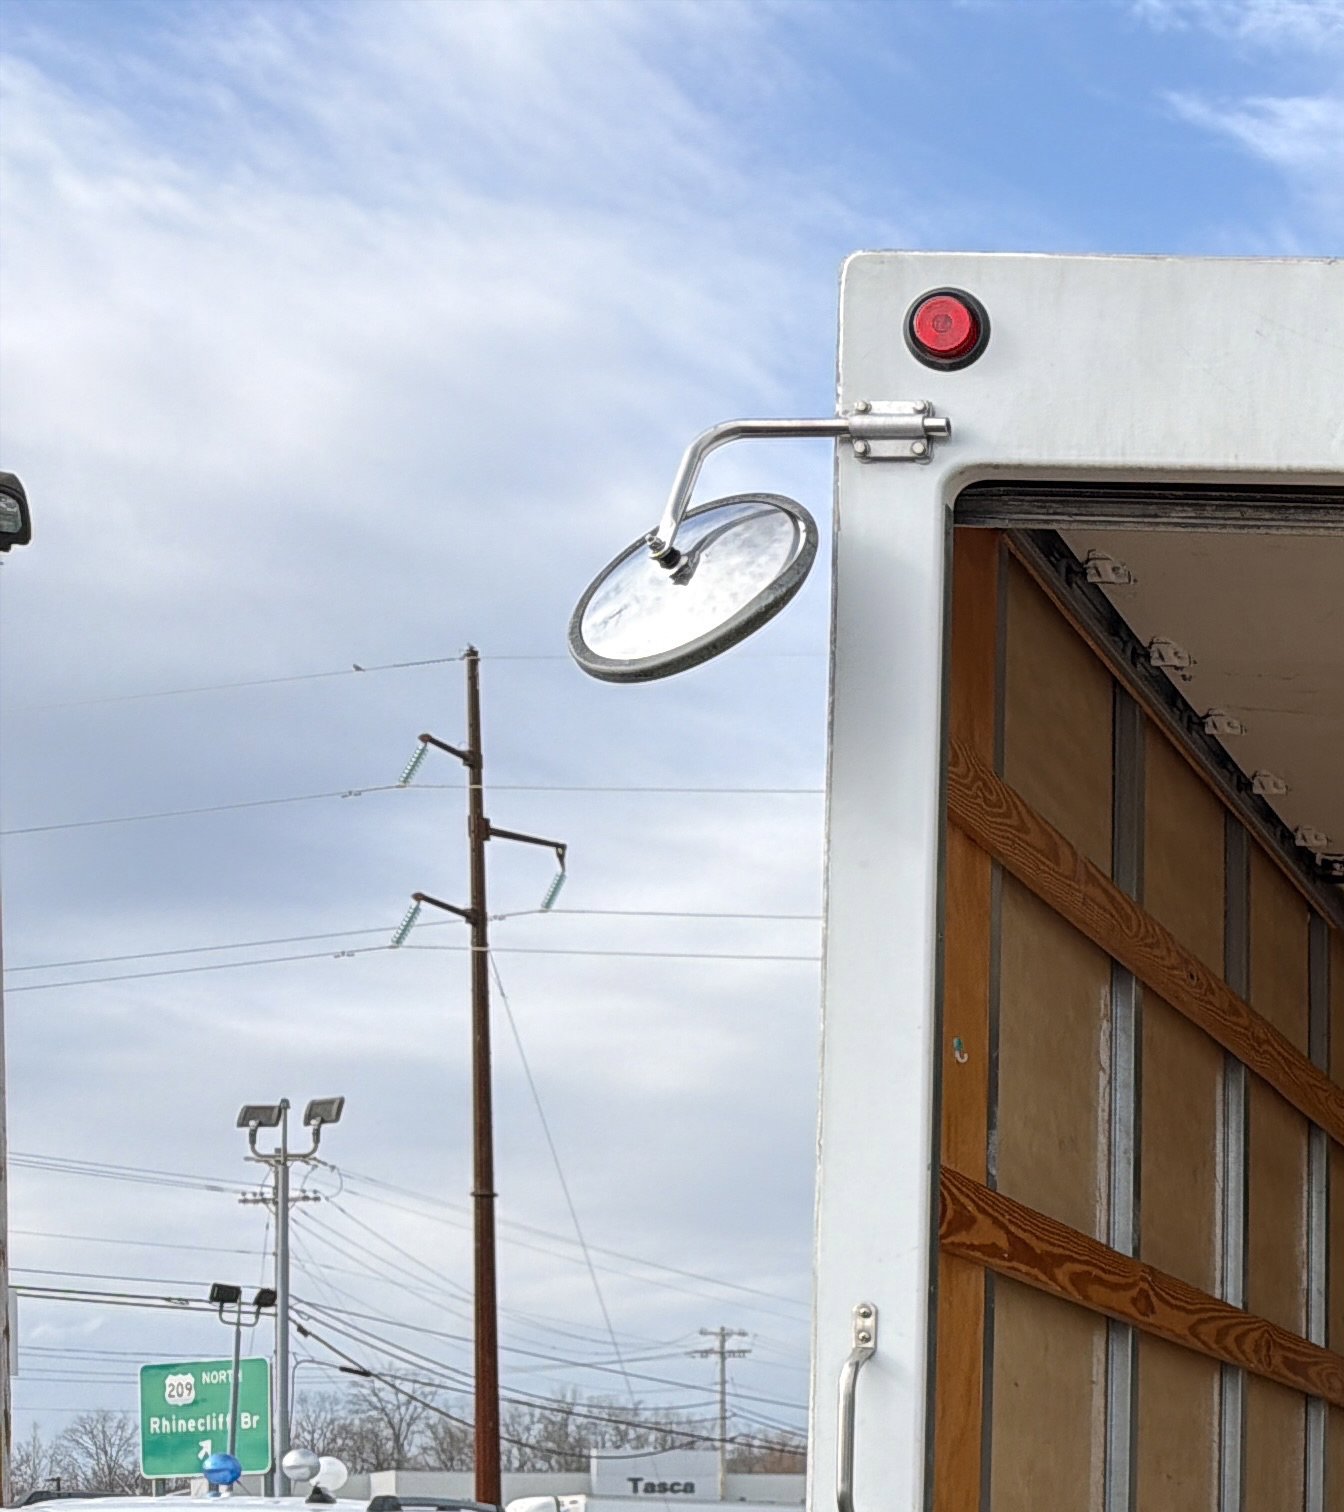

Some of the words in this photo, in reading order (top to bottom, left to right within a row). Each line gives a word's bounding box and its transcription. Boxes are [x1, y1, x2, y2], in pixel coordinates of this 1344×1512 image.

[167, 1381, 193, 1399] 209
[240, 1412, 260, 1430] Br
[627, 1477, 696, 1495] Tasca
